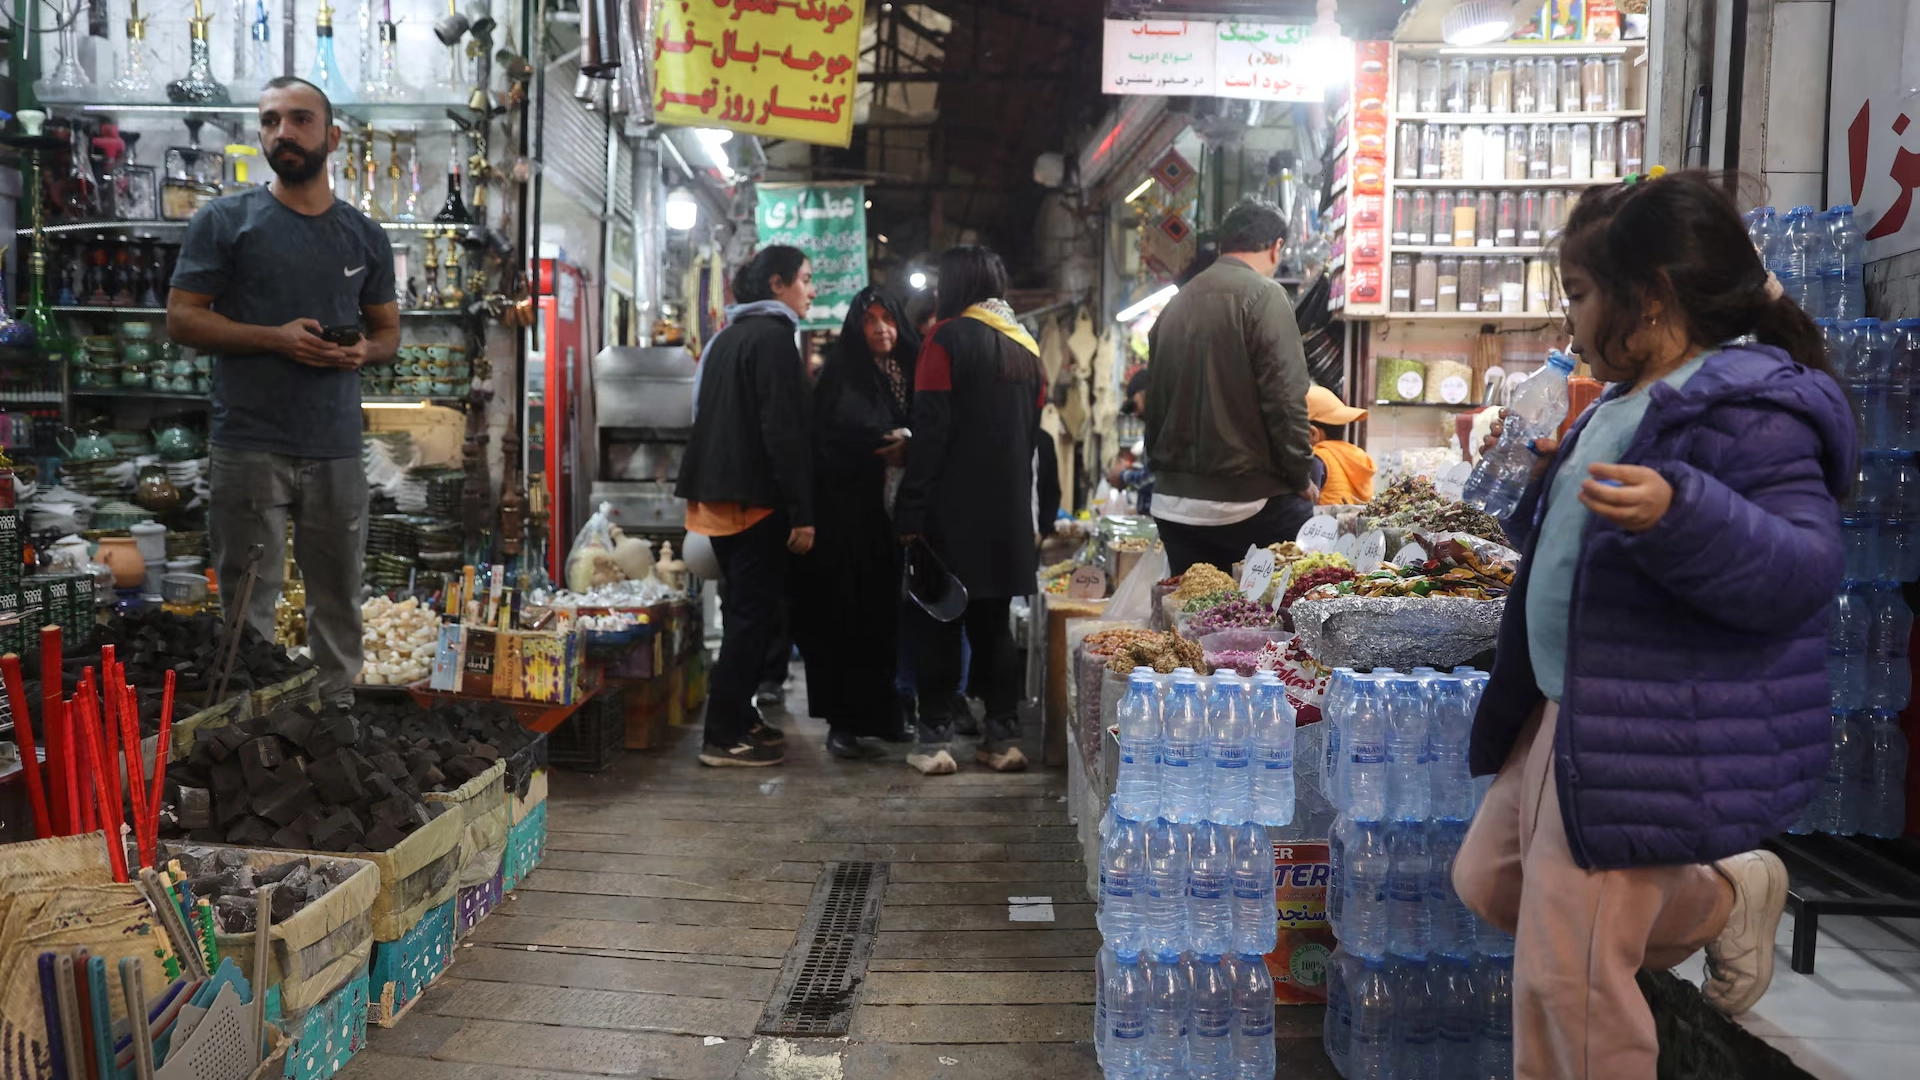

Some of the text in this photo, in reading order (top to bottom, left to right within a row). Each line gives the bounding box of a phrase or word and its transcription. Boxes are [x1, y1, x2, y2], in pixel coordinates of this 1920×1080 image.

[756, 84, 846, 125] کشتار
[765, 190, 855, 228] عطاری
[1274, 847, 1294, 860] ER
[1275, 863, 1331, 887] TER
